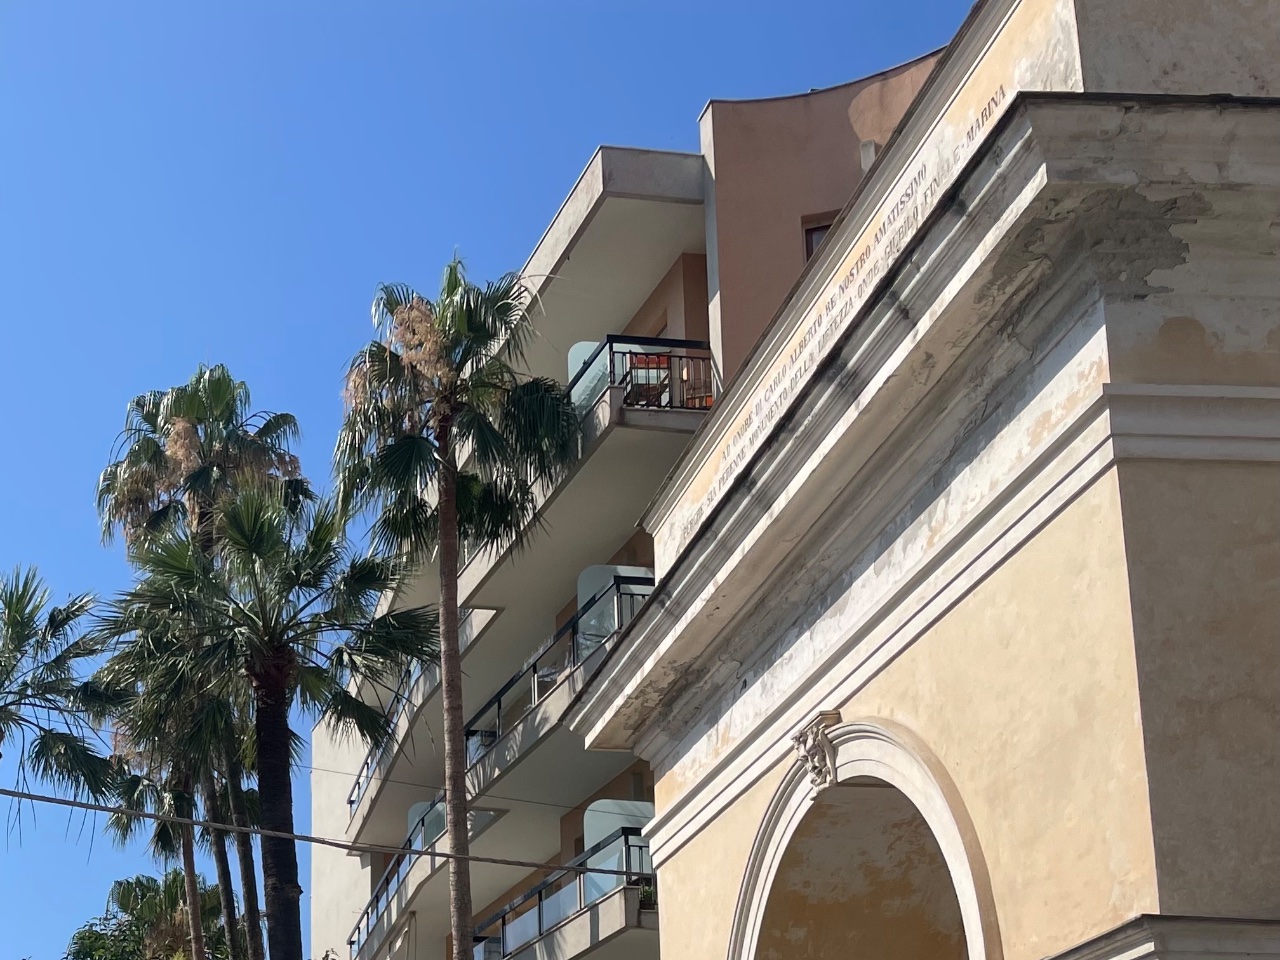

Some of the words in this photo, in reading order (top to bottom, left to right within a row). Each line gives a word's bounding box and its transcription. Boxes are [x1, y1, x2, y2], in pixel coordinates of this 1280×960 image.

[718, 445, 746, 491] PERENNE
[790, 352, 815, 392] DELLA
[857, 260, 880, 299] ONDE
[967, 84, 1006, 147] MARINA
[722, 444, 731, 461] AD
[764, 365, 787, 402] CARLO
[789, 314, 823, 369] ALBERTO
[825, 293, 837, 317] RE
[837, 245, 871, 298] NOSTRO
[873, 162, 927, 252] AMATISSIMO
